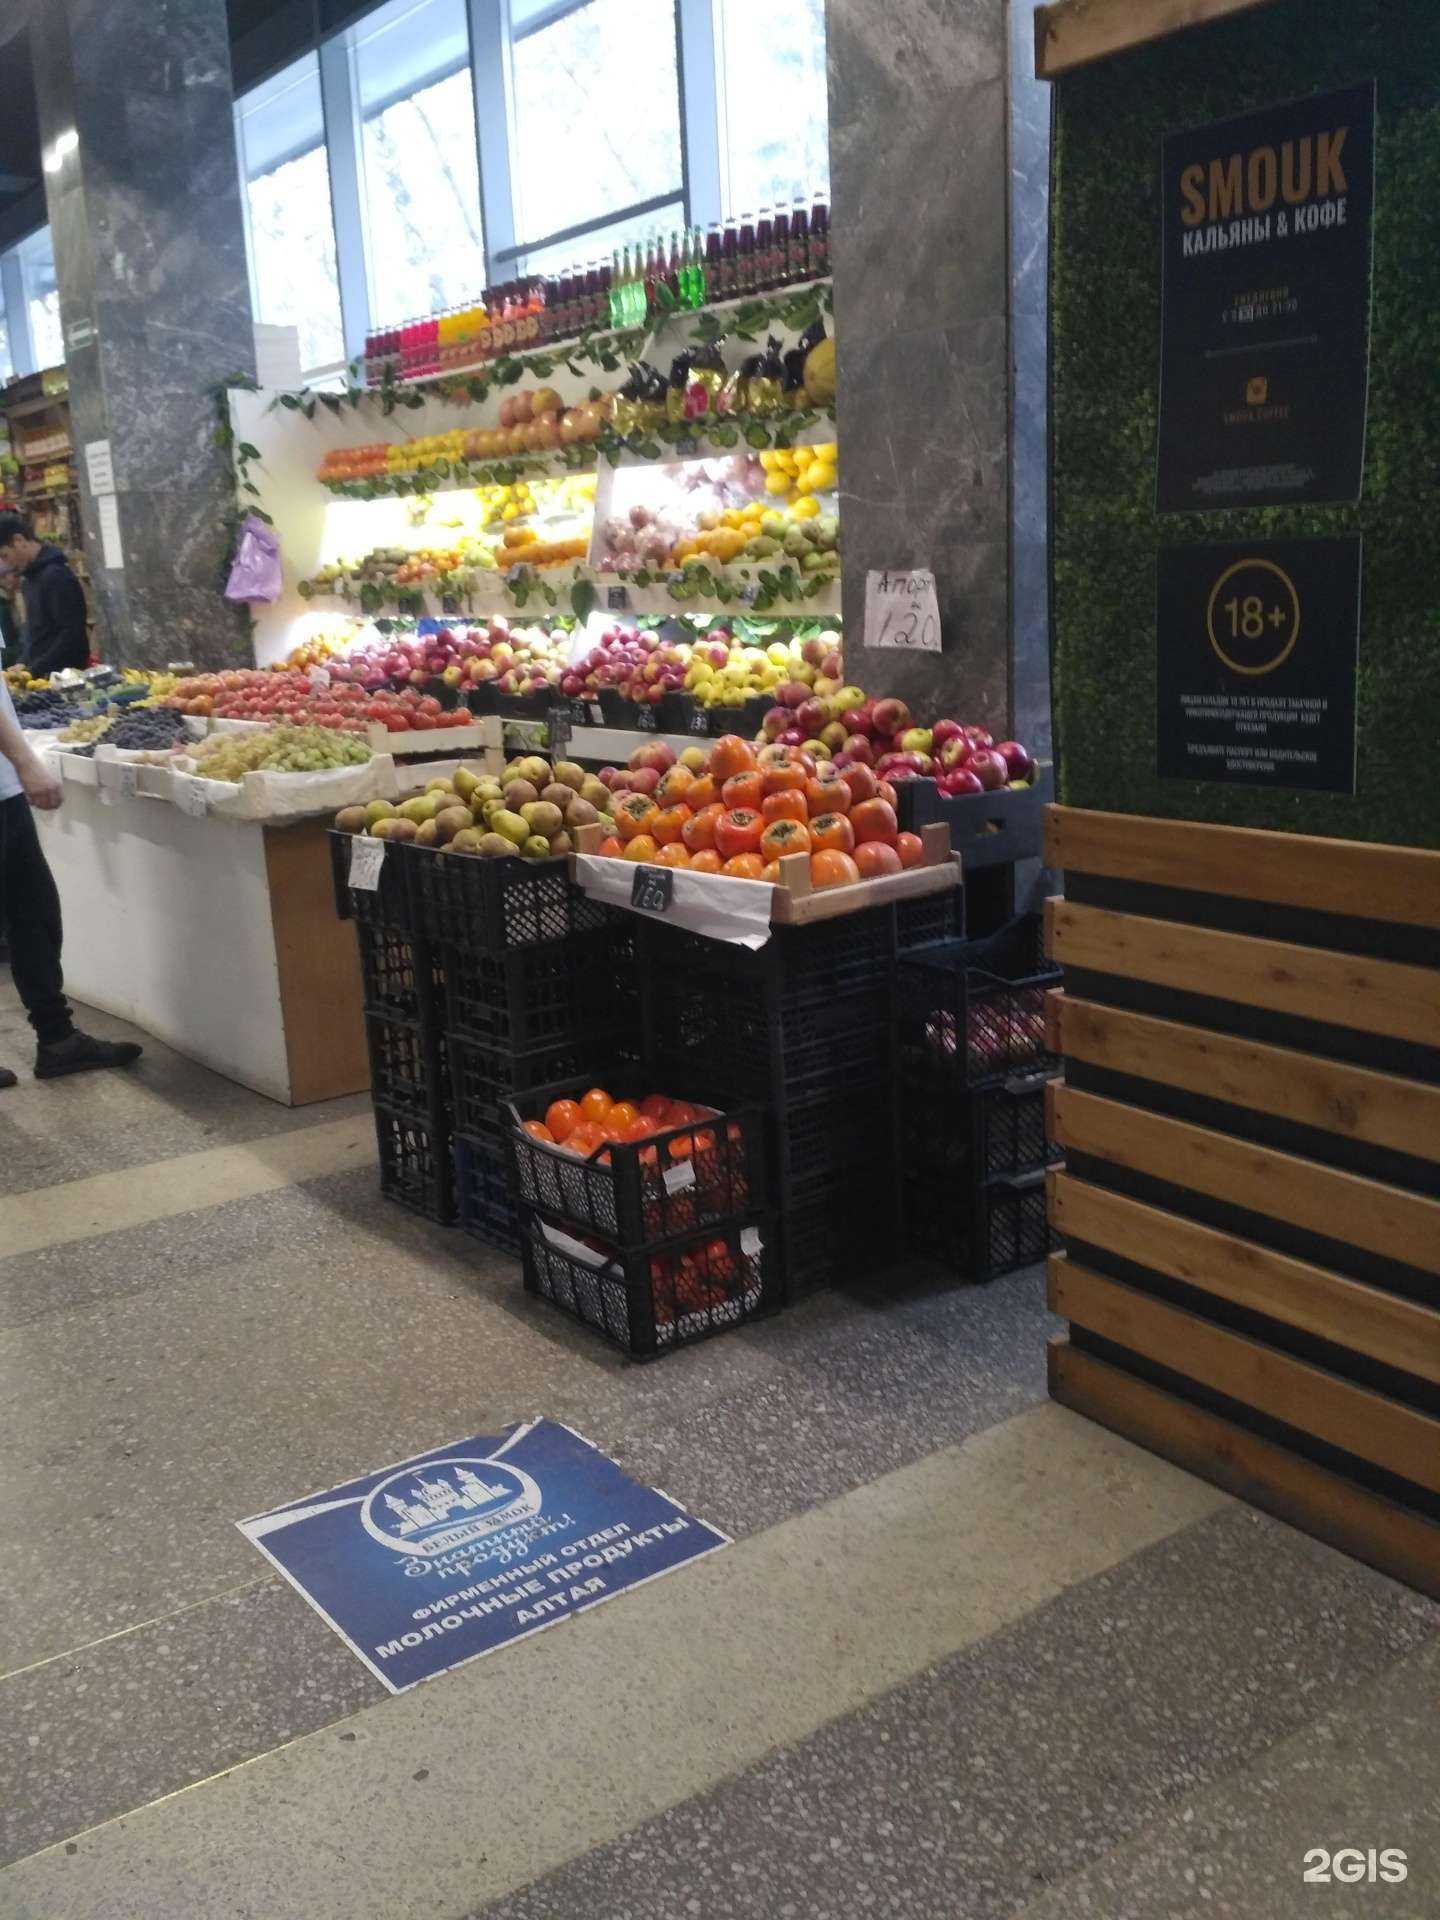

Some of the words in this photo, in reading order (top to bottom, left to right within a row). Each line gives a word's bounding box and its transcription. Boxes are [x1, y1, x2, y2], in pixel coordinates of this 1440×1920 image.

[1180, 126, 1348, 225] SMOUK
[1183, 215, 1271, 257] КАЛЬЯНЫ
[1277, 211, 1288, 238] &
[1294, 198, 1347, 235] КОФЕ
[1224, 596, 1286, 639] 18+
[422, 1525, 481, 1554] БЕЛЫЙ
[374, 1578, 546, 1659] МОЛОЧНЫЕ
[546, 1517, 691, 1585] ПРОДУКТЫ
[411, 1552, 559, 1620] ФИРМЕННЫЙ
[560, 1521, 631, 1557] ОТДЕЛ
[515, 1576, 608, 1625] АЛТАЯ
